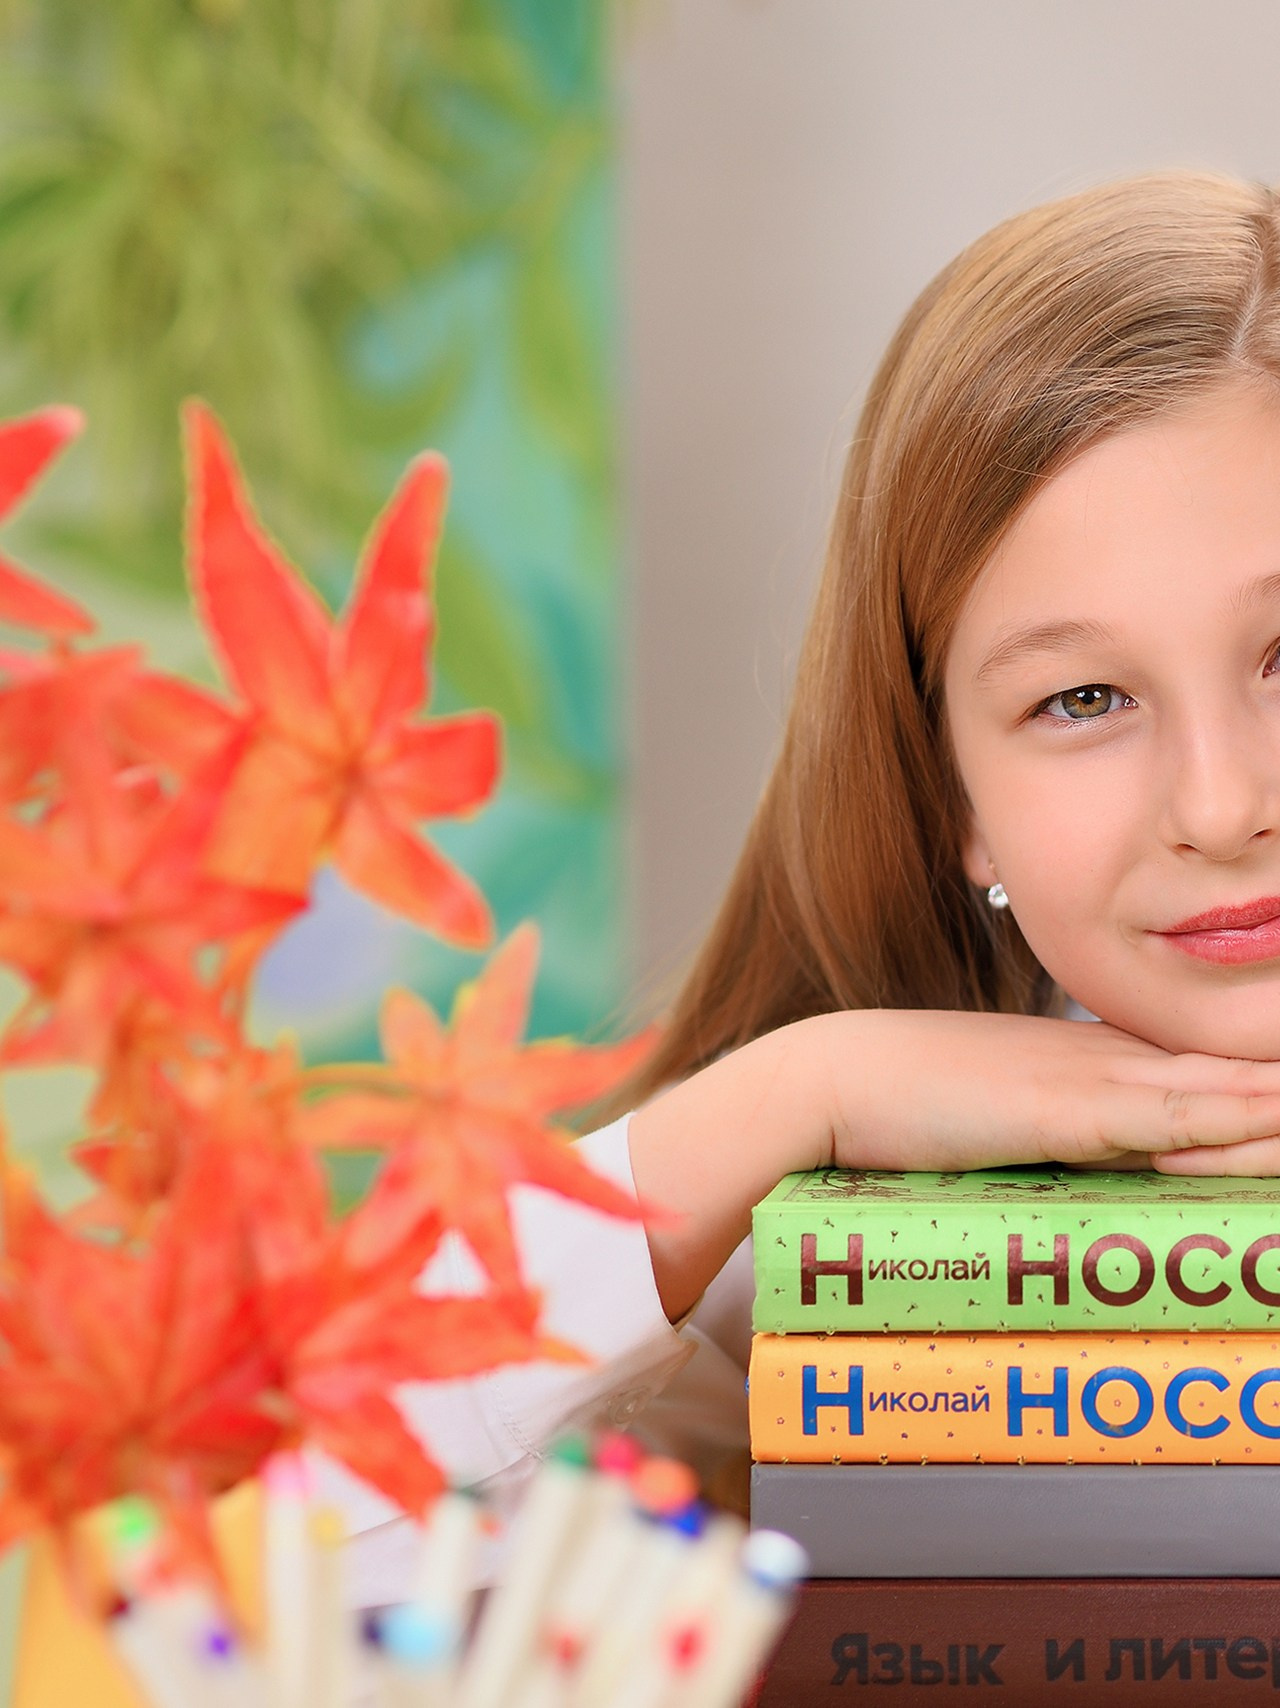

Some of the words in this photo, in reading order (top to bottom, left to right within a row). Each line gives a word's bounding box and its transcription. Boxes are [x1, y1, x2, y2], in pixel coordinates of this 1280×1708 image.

[800, 1232, 991, 1306] Николай
[801, 1365, 991, 1437] Николай
[830, 1631, 1005, 1687] Язык
[1044, 1636, 1086, 1683] и
